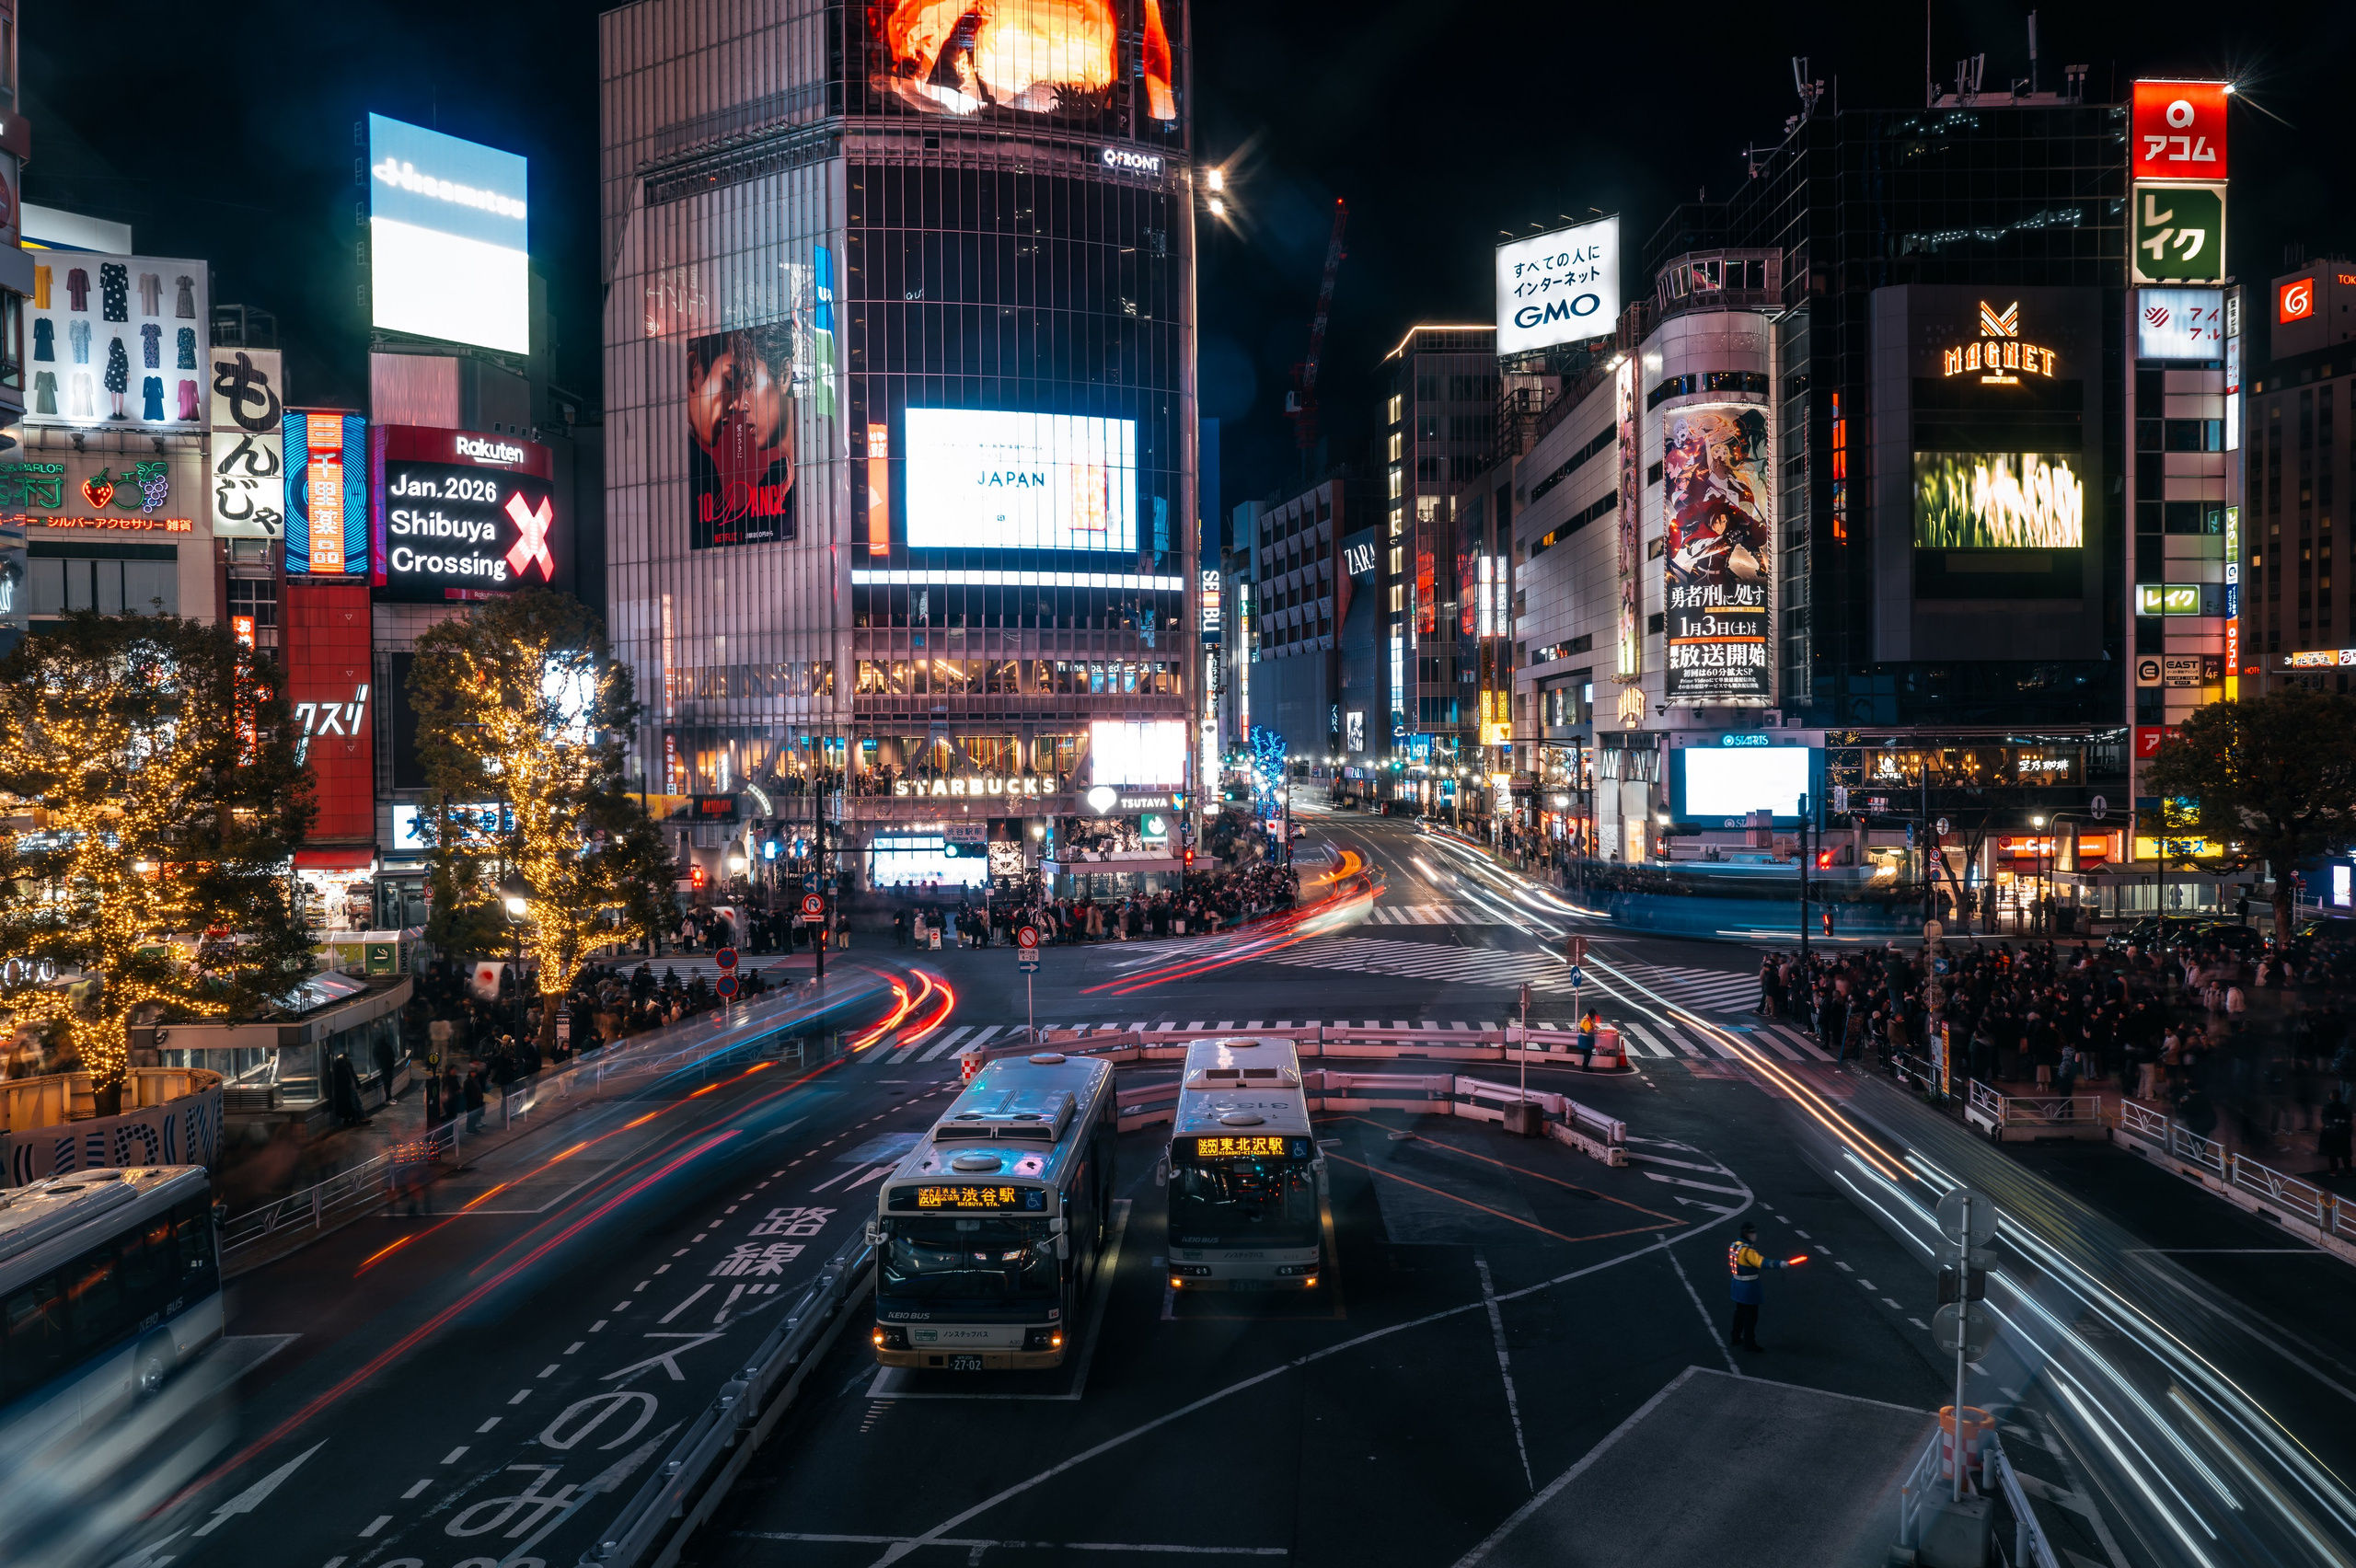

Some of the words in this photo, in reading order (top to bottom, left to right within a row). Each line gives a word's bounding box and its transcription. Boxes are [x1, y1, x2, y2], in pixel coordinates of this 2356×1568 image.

[2143, 135, 2216, 161] アコム
[2142, 195, 2205, 260] レイク
[1514, 245, 1600, 278] すべての人に
[1514, 266, 1600, 297] インターネット
[1514, 293, 1600, 329] GMO
[1945, 341, 2055, 376] MAGNET
[214, 352, 283, 535] もんじゃ
[456, 436, 524, 463] Rakuten
[977, 470, 1045, 488] JAPAN
[313, 422, 340, 564] 三千里薬品
[390, 510, 496, 543] Shibuya
[714, 532, 737, 543] NETFLIX
[2228, 513, 2236, 540] レイク
[391, 548, 507, 582] Crossing
[1345, 542, 1375, 575] ZARA
[1202, 570, 1220, 632] SEIBU
[1670, 583, 1765, 609] 勇者刑に処す
[2147, 590, 2195, 607] レイク
[1091, 662, 1119, 672] baed
[2166, 661, 2199, 669] EAST
[1735, 735, 1769, 745] STARTS
[2018, 758, 2069, 771] 星乃珈琲
[895, 778, 1055, 795] STARBUCKS
[1121, 798, 1168, 808] TSUTAYA
[946, 827, 983, 836] 渋谷駅前
[1219, 1137, 1284, 1151] 東北沢駅
[962, 1187, 1015, 1203] 渋谷駅
[167, 1297, 183, 1316] BUS
[888, 1311, 909, 1320] KEIO
